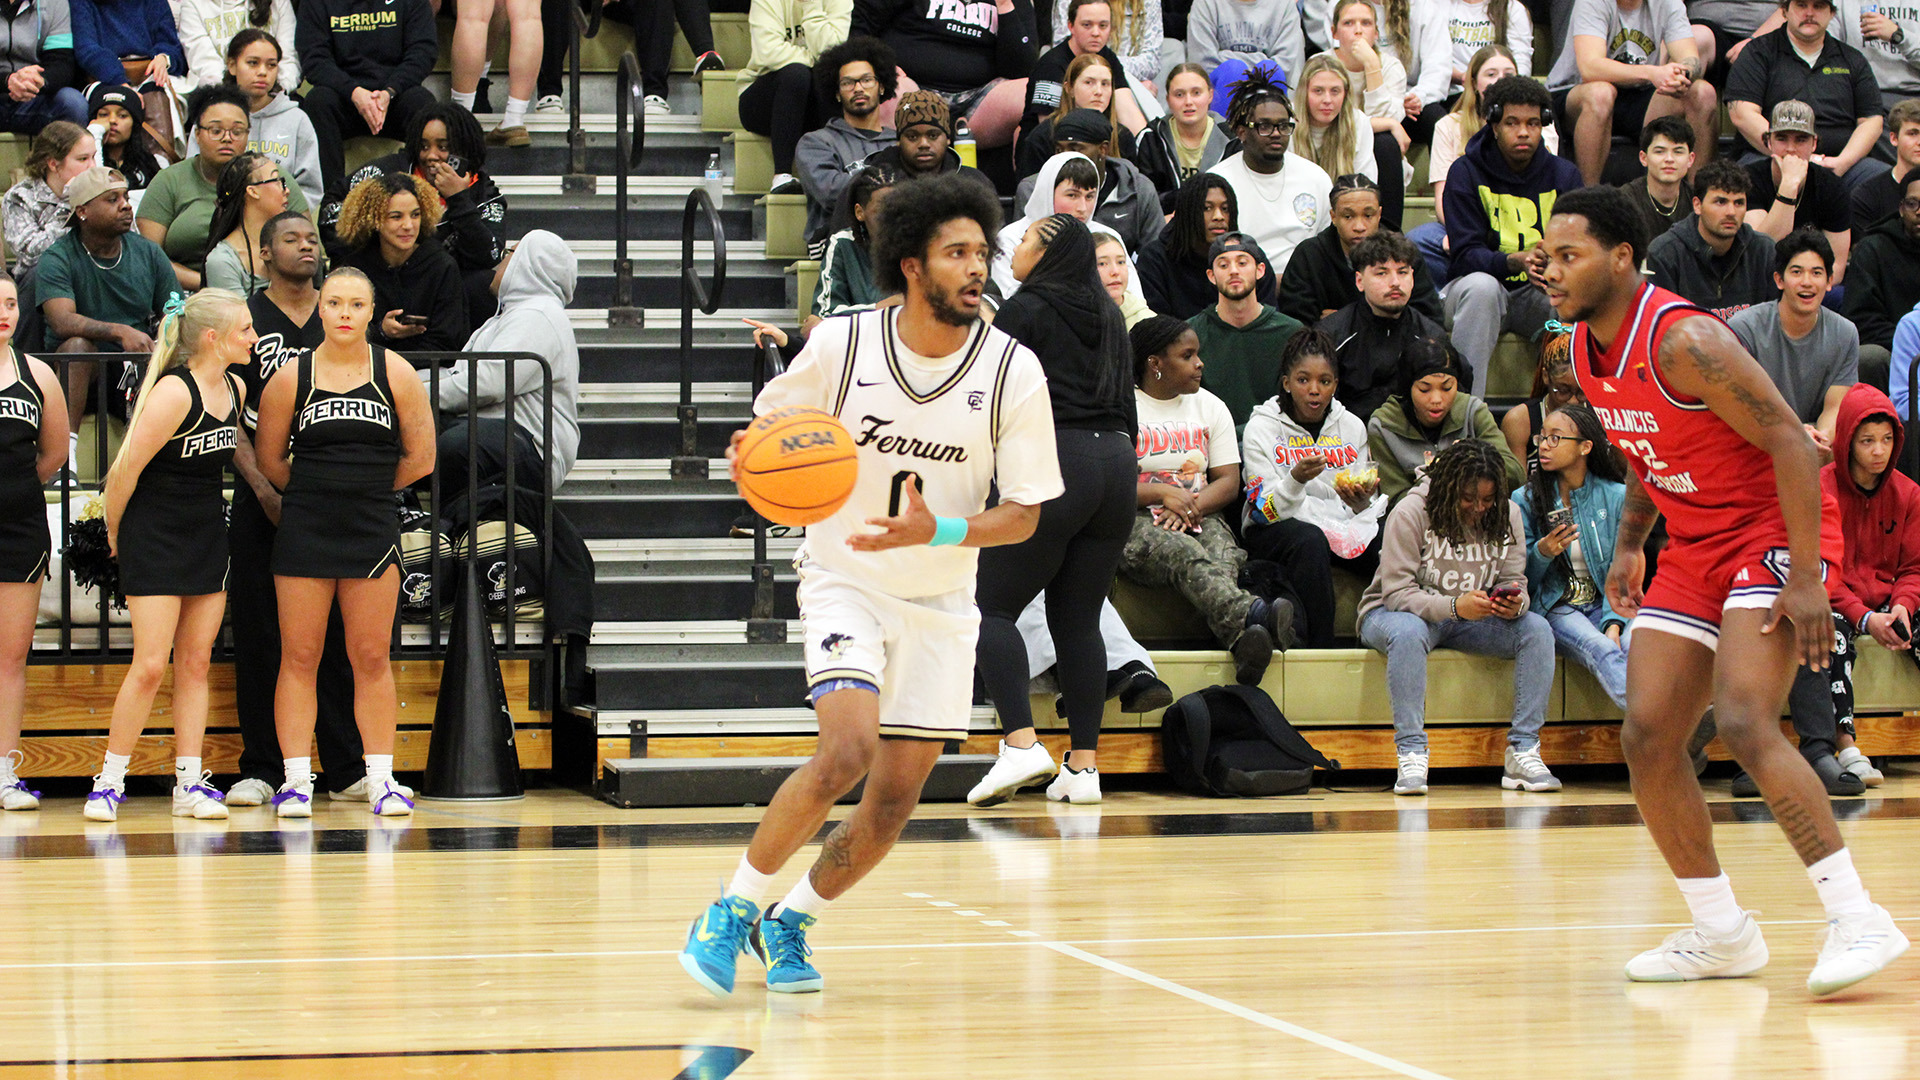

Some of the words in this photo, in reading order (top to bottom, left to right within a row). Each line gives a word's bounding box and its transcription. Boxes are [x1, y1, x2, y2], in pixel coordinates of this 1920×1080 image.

[330, 10, 397, 28] FERRUM
[946, 22, 982, 37] COLLEGE
[1879, 6, 1918, 22] RRUM
[1448, 25, 1495, 41] FTBAL
[248, 140, 290, 157] RUM
[255, 332, 311, 379] Fer
[0, 396, 39, 429] RUM
[299, 397, 392, 432] FERRUM
[181, 426, 238, 458] FERR
[855, 415, 968, 463] Ferrum
[1420, 529, 1510, 561] Mentl
[1419, 559, 1500, 592] healt
